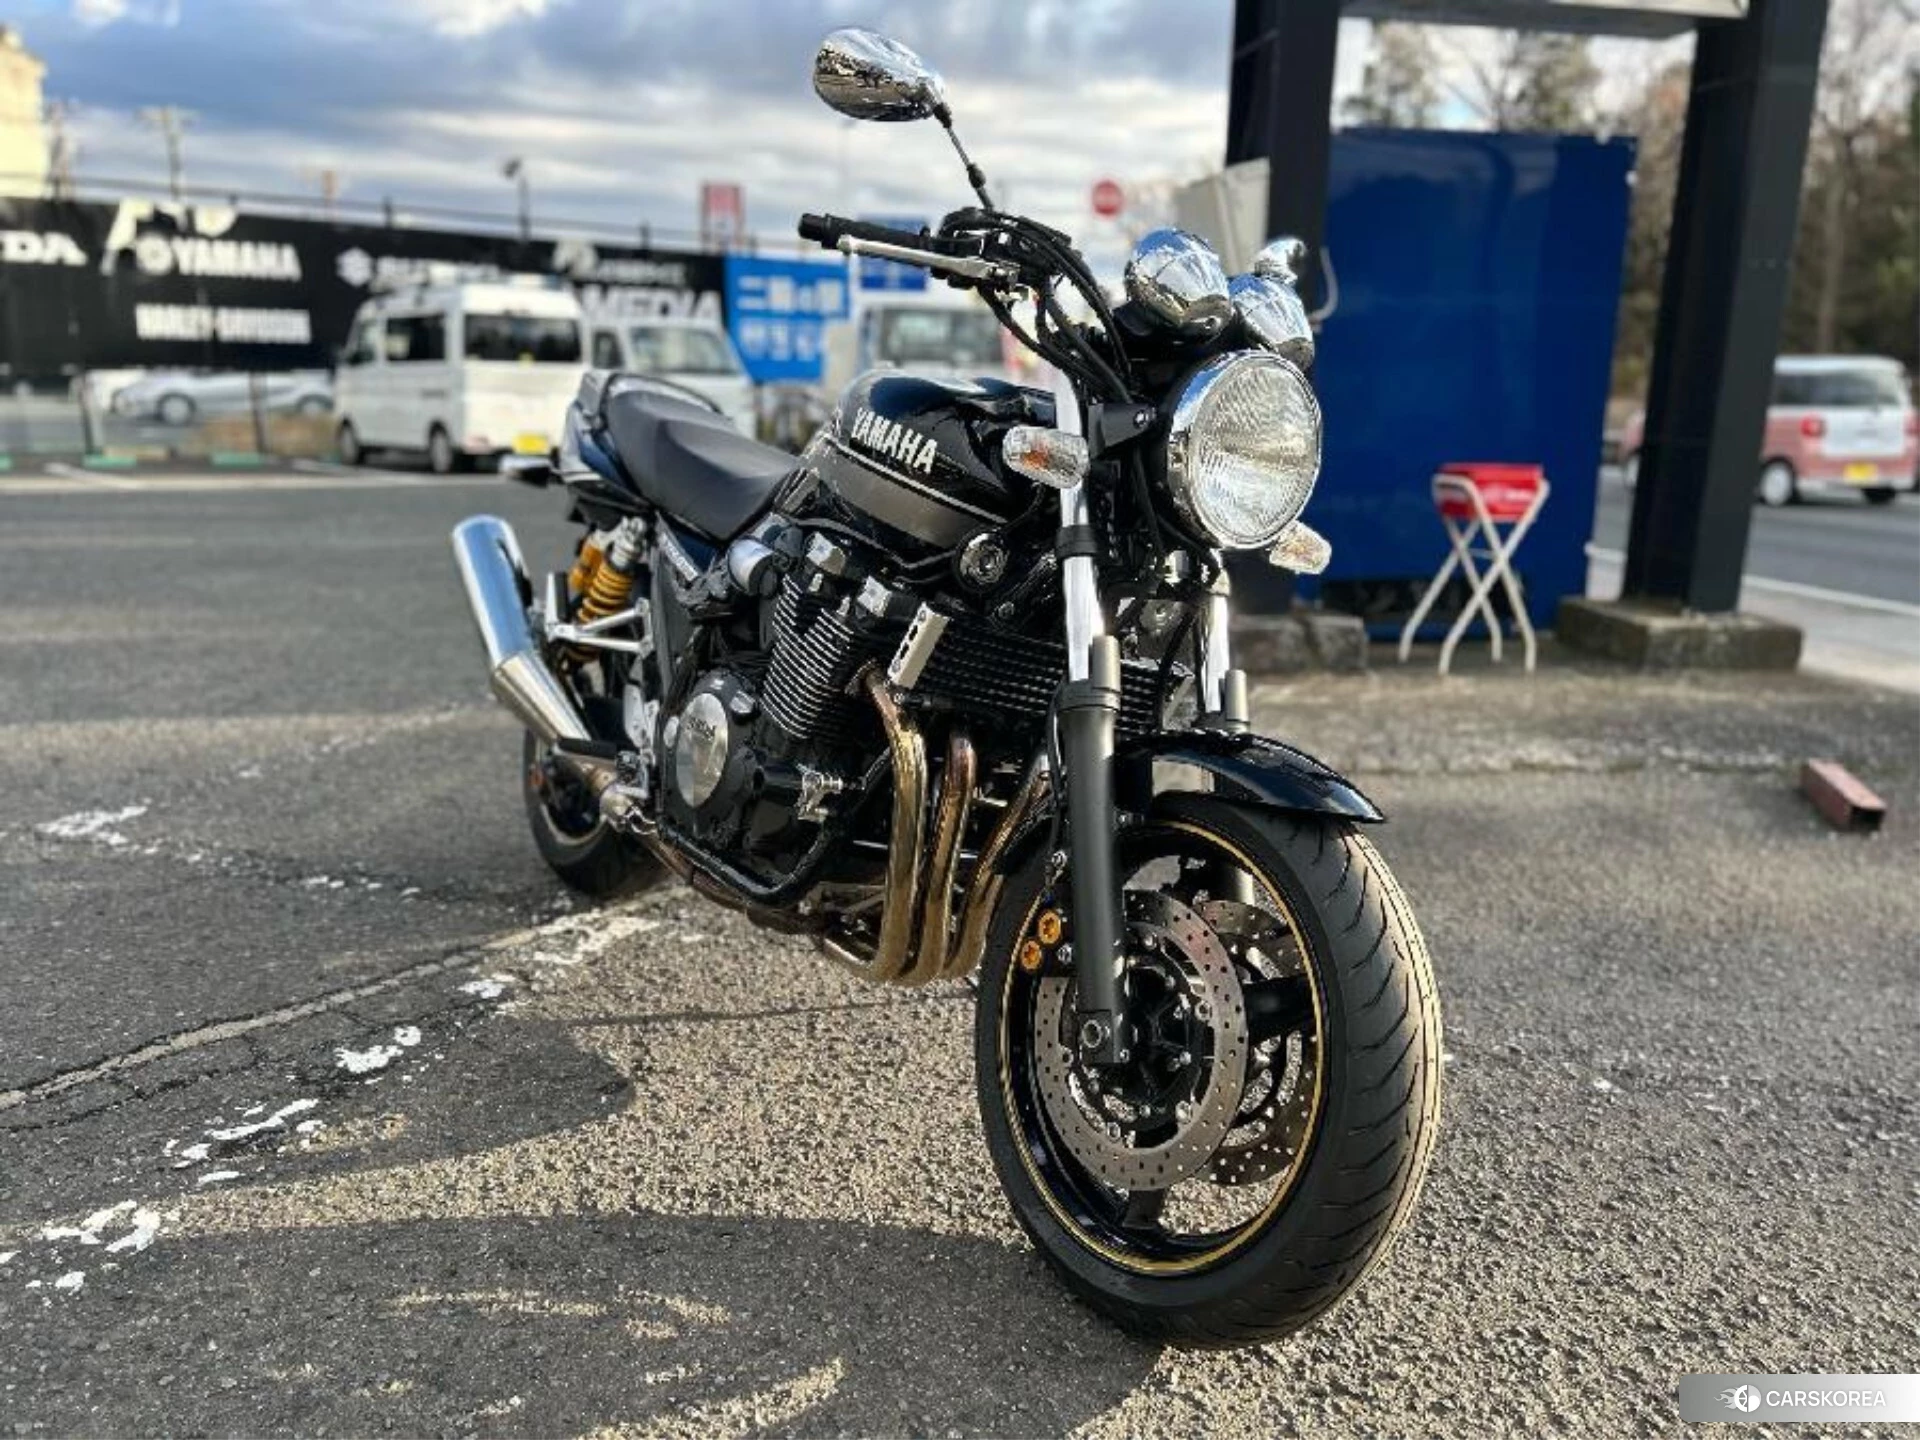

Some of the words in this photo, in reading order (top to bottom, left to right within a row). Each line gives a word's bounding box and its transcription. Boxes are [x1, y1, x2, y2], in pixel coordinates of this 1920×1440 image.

[0, 231, 87, 266] DA
[171, 238, 301, 281] YAMAHA
[851, 407, 938, 474] YAMAHA
